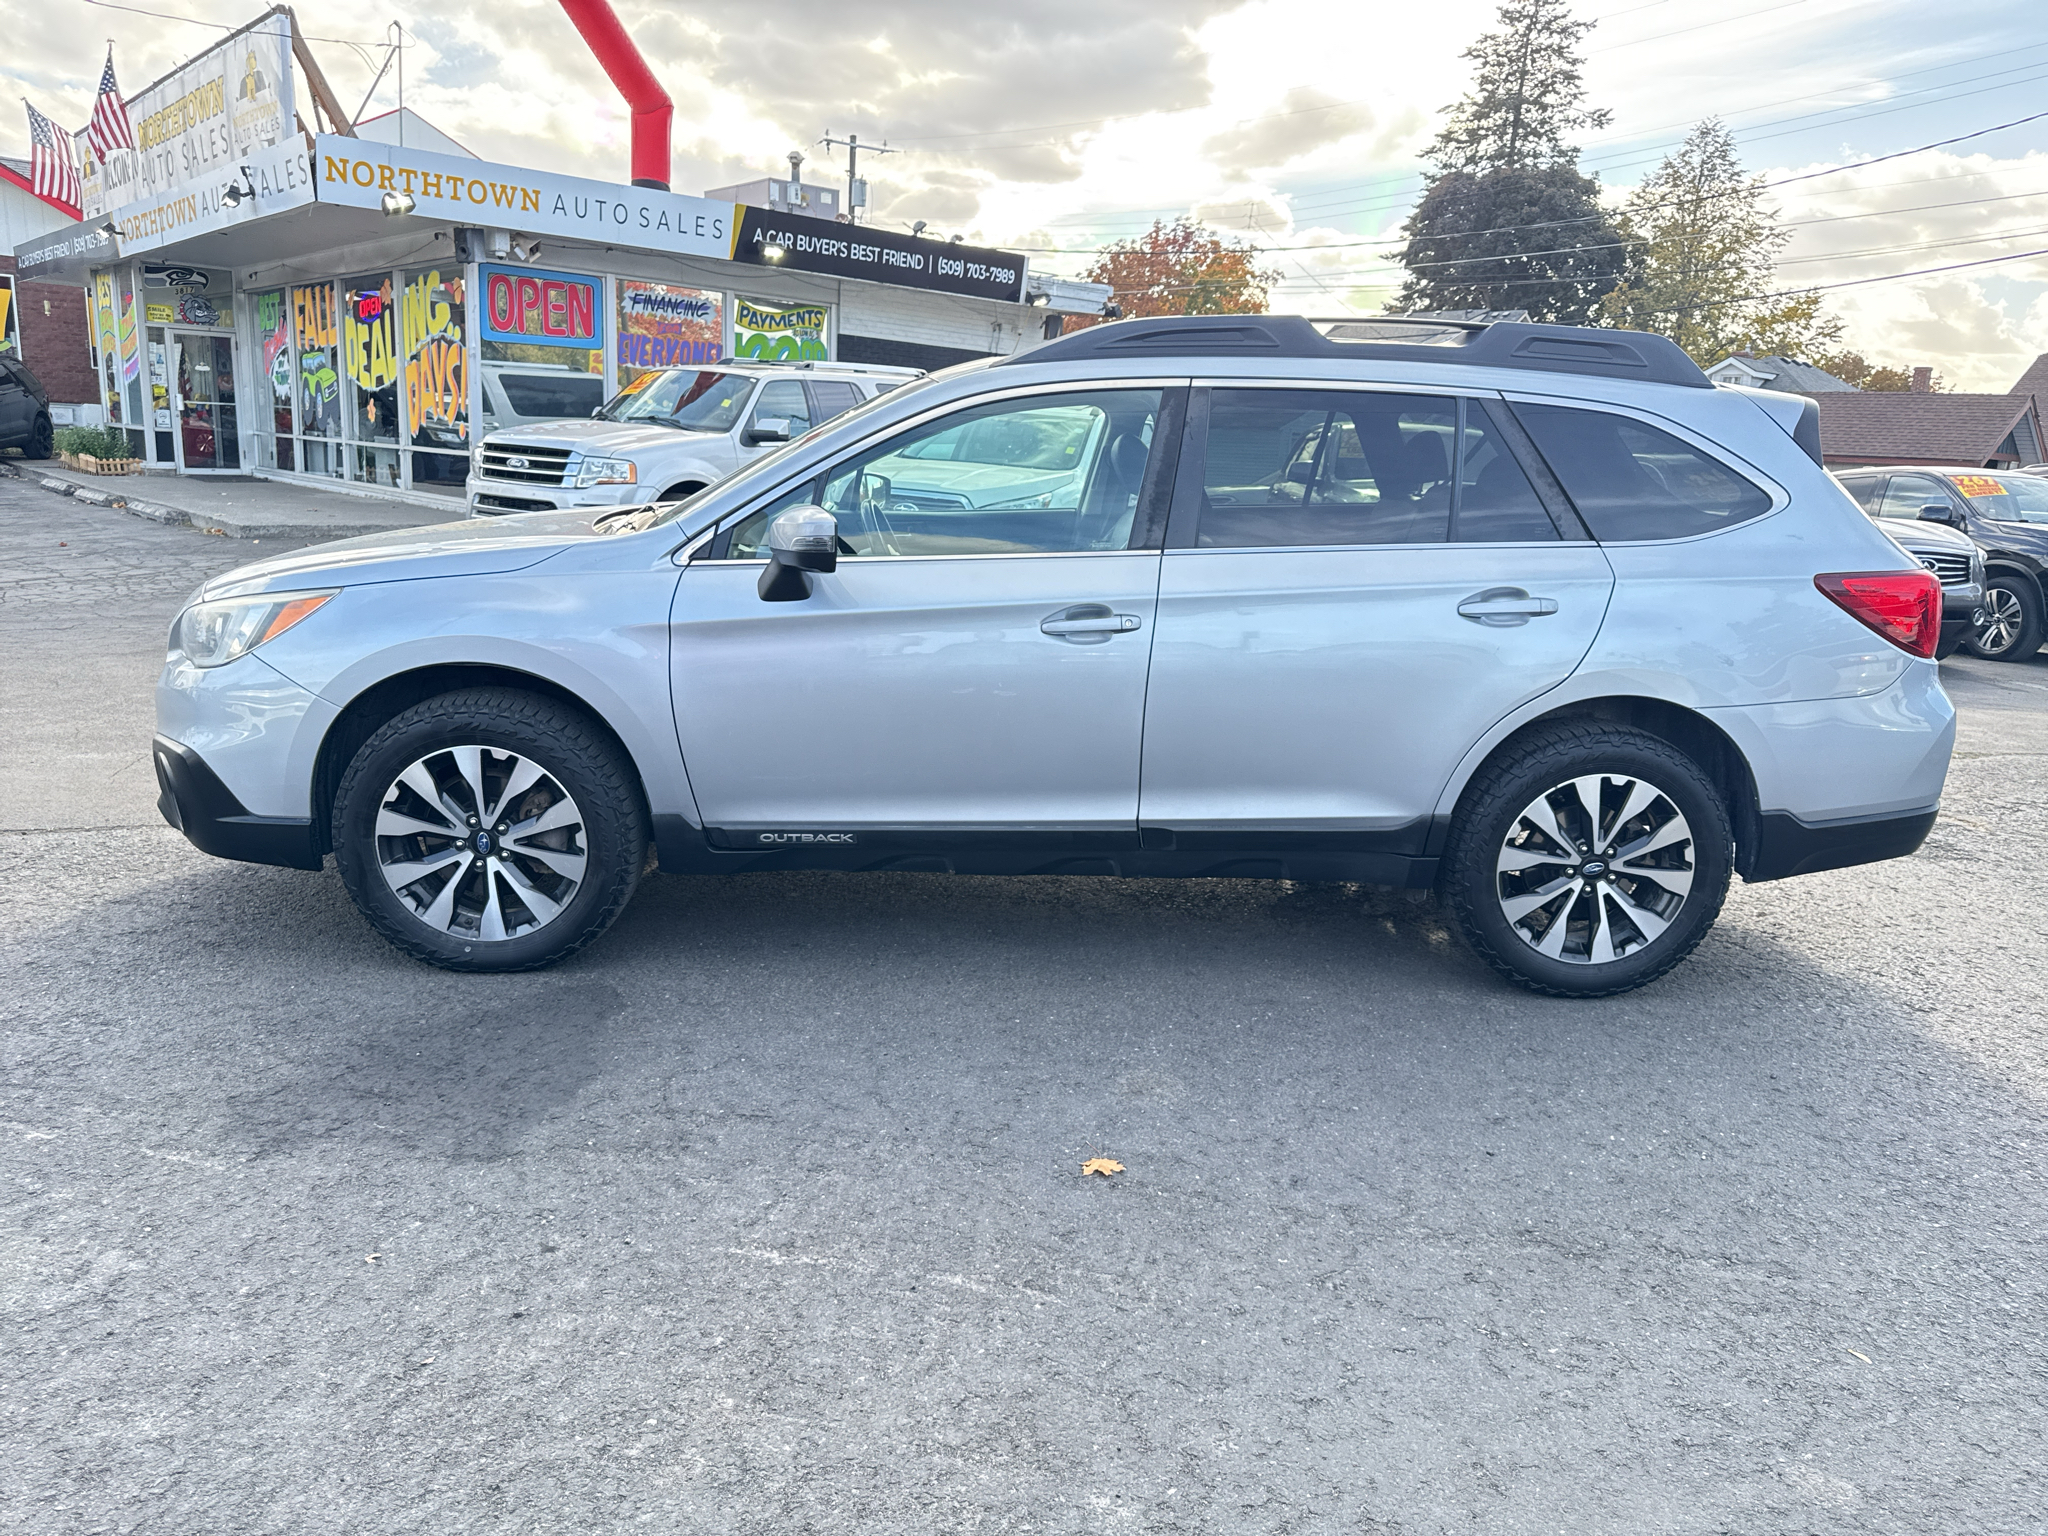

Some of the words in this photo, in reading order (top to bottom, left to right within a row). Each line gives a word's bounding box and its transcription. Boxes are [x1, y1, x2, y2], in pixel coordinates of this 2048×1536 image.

[138, 75, 224, 154] NORTHTOWN
[254, 116, 281, 138] SALES
[142, 150, 174, 189] AUTO
[182, 123, 229, 171] SALES
[118, 193, 198, 245] NORTHTOWN
[324, 155, 541, 213] NORTHTOWN
[552, 193, 629, 225] AUTO
[638, 207, 724, 240] SALES
[753, 227, 763, 243] A
[766, 230, 794, 250] CAR
[796, 234, 848, 258] BUYER'S
[850, 243, 881, 263] BEST
[882, 248, 924, 270] FRIEND
[937, 256, 964, 279] (509)
[966, 263, 1016, 285] 703-7989
[175, 286, 195, 296] 3817
[258, 292, 280, 332] BEST
[294, 284, 338, 351] FALL
[359, 296, 382, 319] OPEN
[488, 274, 594, 338] OPEN
[631, 292, 711, 318] FINANCING
[740, 304, 824, 330] PAYMENTS
[345, 309, 397, 390] DEAL
[405, 341, 468, 441] DAYS!
[760, 833, 853, 842] OUTBACK
